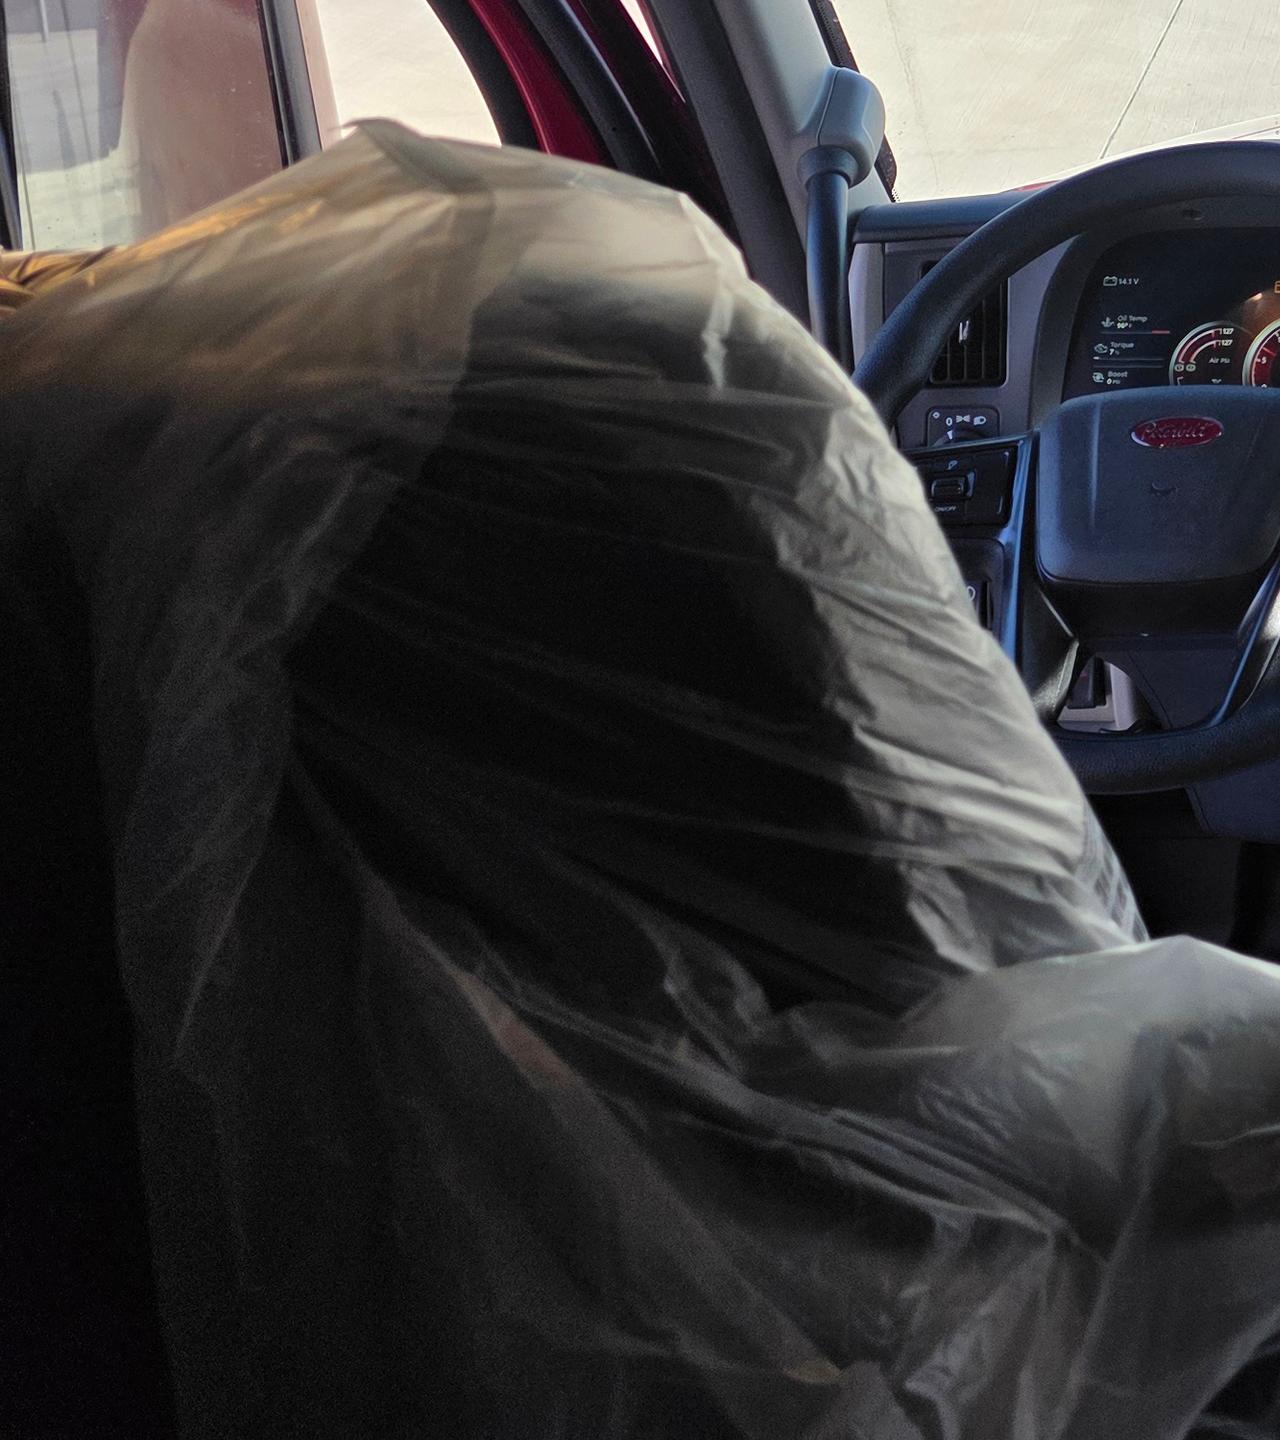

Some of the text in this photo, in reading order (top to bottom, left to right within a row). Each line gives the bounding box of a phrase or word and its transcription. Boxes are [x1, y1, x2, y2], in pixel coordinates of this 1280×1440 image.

[1129, 315, 1148, 323] Temp
[1222, 327, 1234, 335] 127
[1110, 341, 1134, 350] Torque
